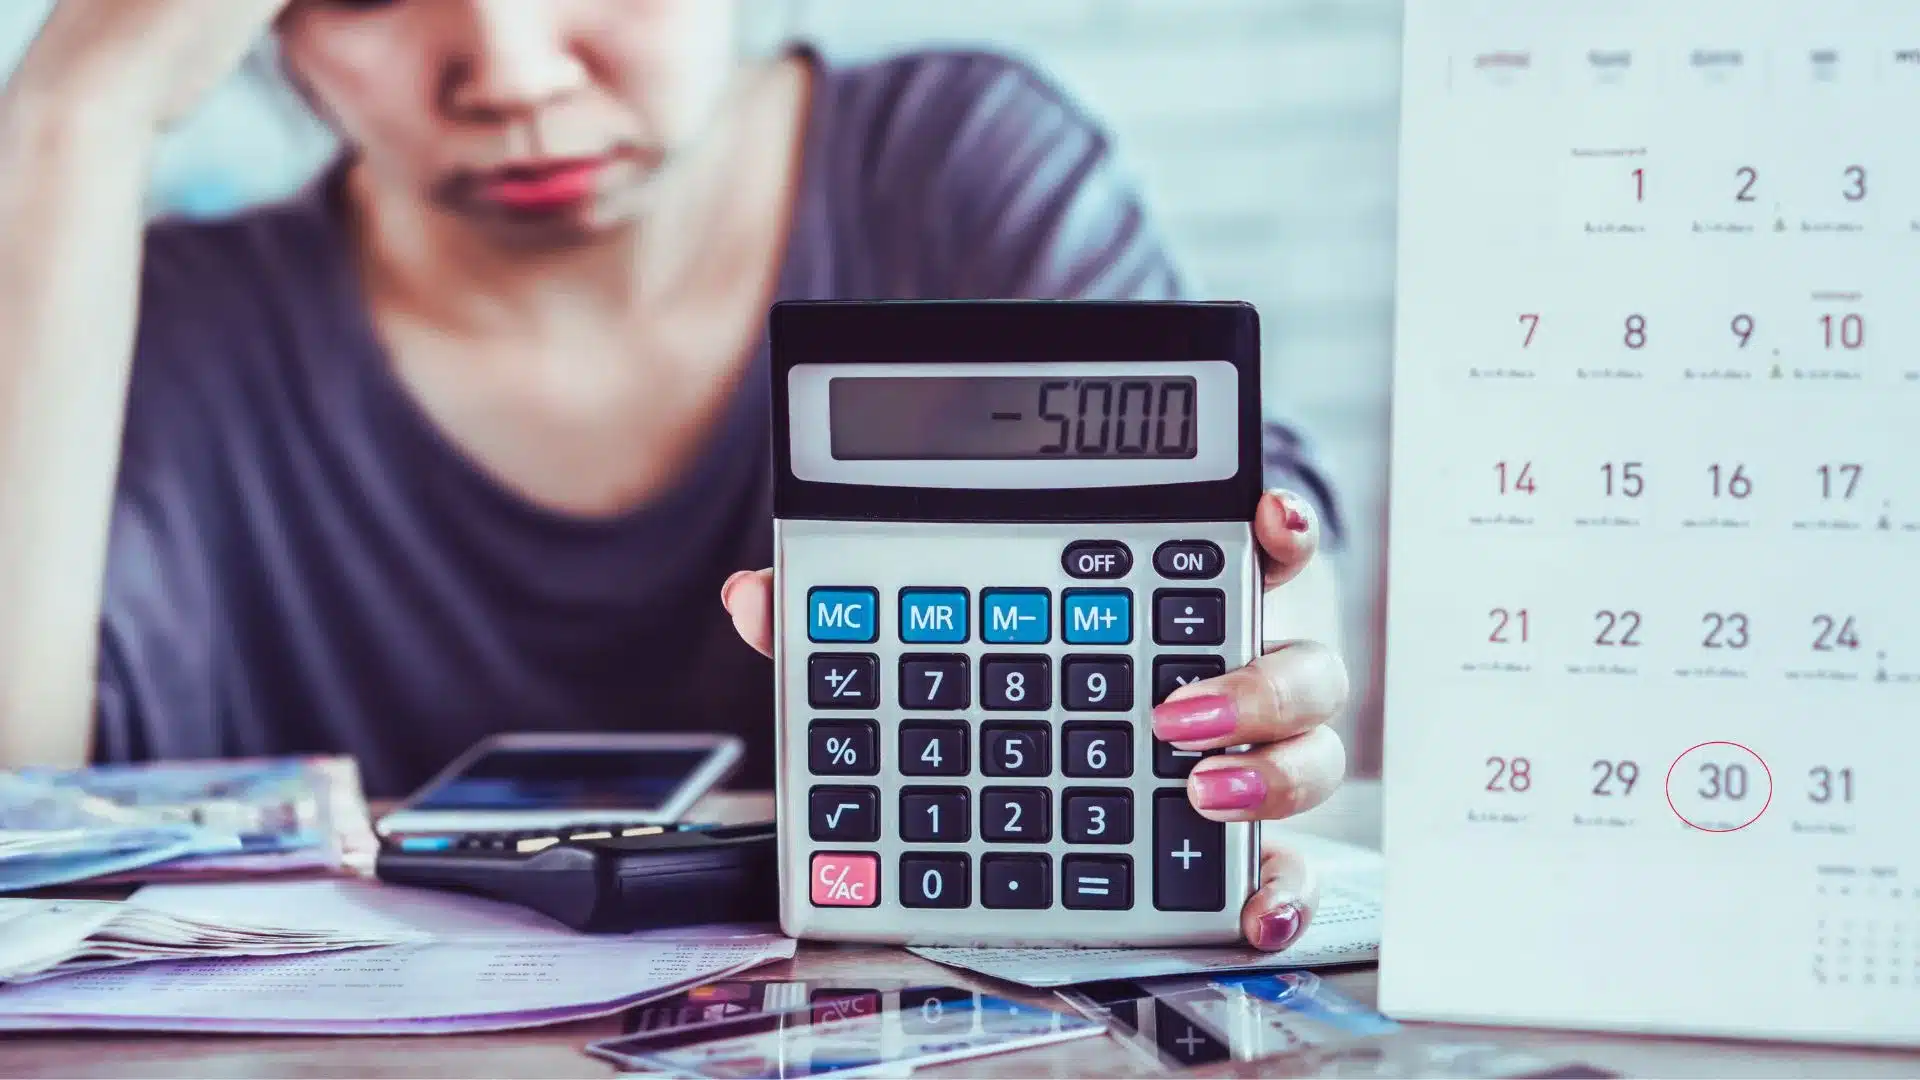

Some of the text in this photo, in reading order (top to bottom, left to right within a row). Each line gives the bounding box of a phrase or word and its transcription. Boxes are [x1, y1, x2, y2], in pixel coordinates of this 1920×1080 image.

[1631, 164, 1867, 203] 1 2 3
[1518, 313, 1864, 350] 7 8 9 10
[1496, 461, 1862, 499] 14 15 16 17
[1078, 552, 1203, 573] OFF ON
[818, 602, 862, 629] MC
[910, 605, 954, 630] MR
[1074, 606, 1117, 631] M+
[1488, 608, 1860, 651] 21 22 23 24
[924, 671, 944, 701] 7
[1005, 671, 1025, 702] 8
[1087, 672, 1107, 703] 9
[826, 737, 857, 765] %
[920, 738, 943, 767] 4
[1005, 739, 1024, 769] 5
[1086, 739, 1107, 769] 6
[1485, 756, 1852, 804] 28 29 30 31
[925, 803, 942, 834] 1
[1004, 802, 1022, 832] 2
[1086, 805, 1106, 835] 3
[1171, 838, 1202, 870] +
[819, 864, 864, 900] C/AC
[922, 869, 943, 899] 0
[1078, 877, 1109, 895] =
